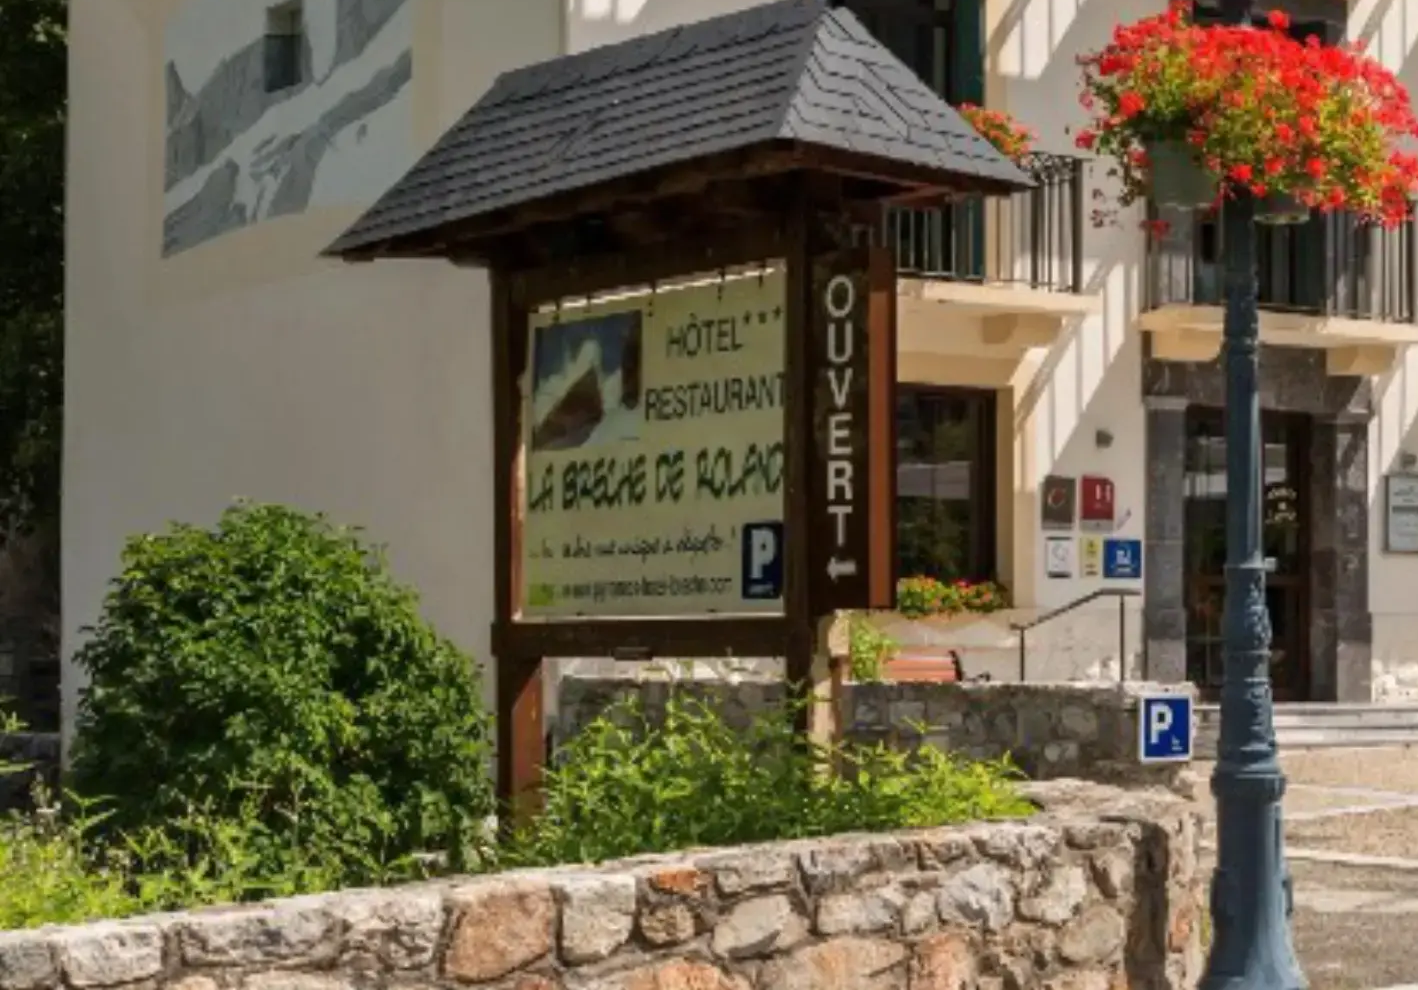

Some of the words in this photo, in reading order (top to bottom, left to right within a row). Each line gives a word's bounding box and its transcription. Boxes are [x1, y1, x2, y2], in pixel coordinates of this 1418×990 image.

[644, 371, 785, 422] RESTAURANT
[825, 275, 856, 547] OUVERT
[528, 463, 554, 512] LA
[655, 450, 685, 503] DE
[750, 528, 777, 580] P
[1150, 703, 1173, 744] P
